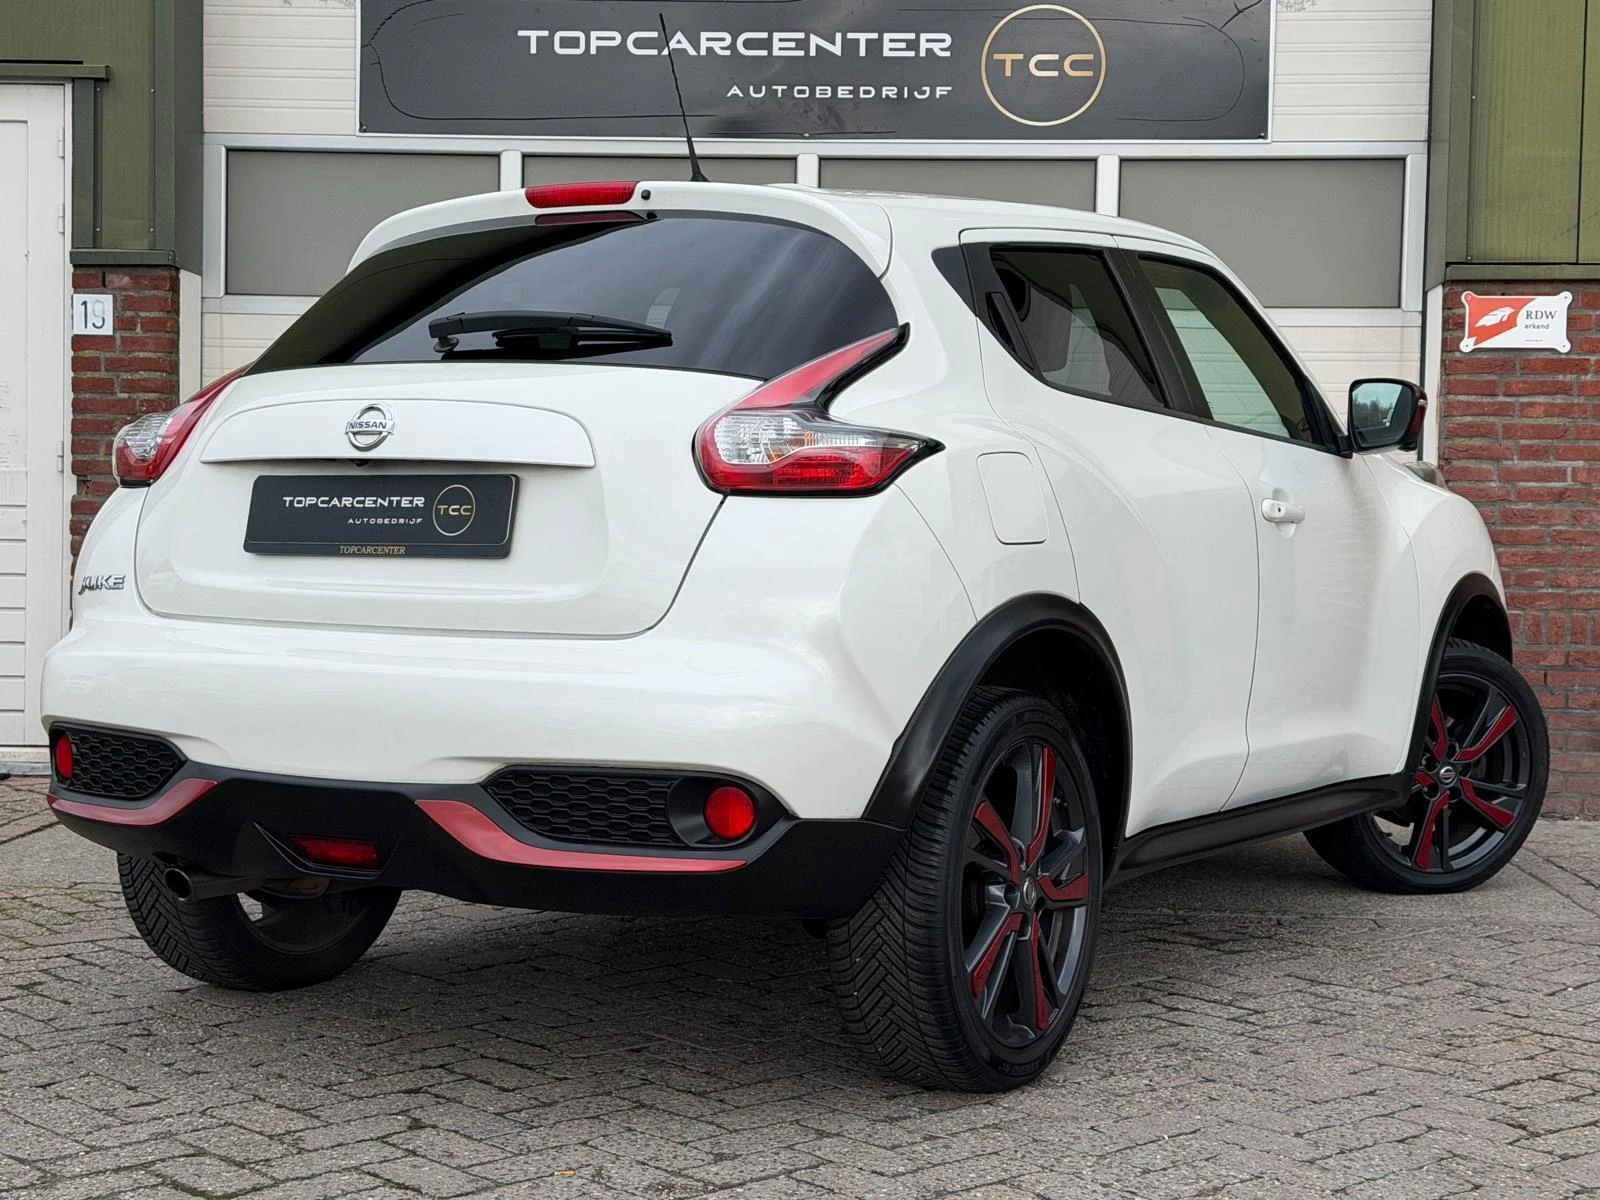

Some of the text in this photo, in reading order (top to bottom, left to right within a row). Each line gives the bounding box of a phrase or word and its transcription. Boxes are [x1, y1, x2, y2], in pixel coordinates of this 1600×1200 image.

[517, 29, 952, 57] TOPCARCENTER
[992, 53, 1095, 78] TCC
[726, 84, 953, 100] AUTOBEDRIJF
[80, 299, 106, 329] 19
[1525, 309, 1558, 320] RDW
[1524, 322, 1550, 330] erkend
[348, 420, 388, 430] NISSAN
[282, 495, 426, 509] TOPCARCENTER
[437, 504, 473, 517] TCC
[347, 517, 424, 526] AUTOBEDRIJF
[338, 544, 406, 556] TOPCARCENTER
